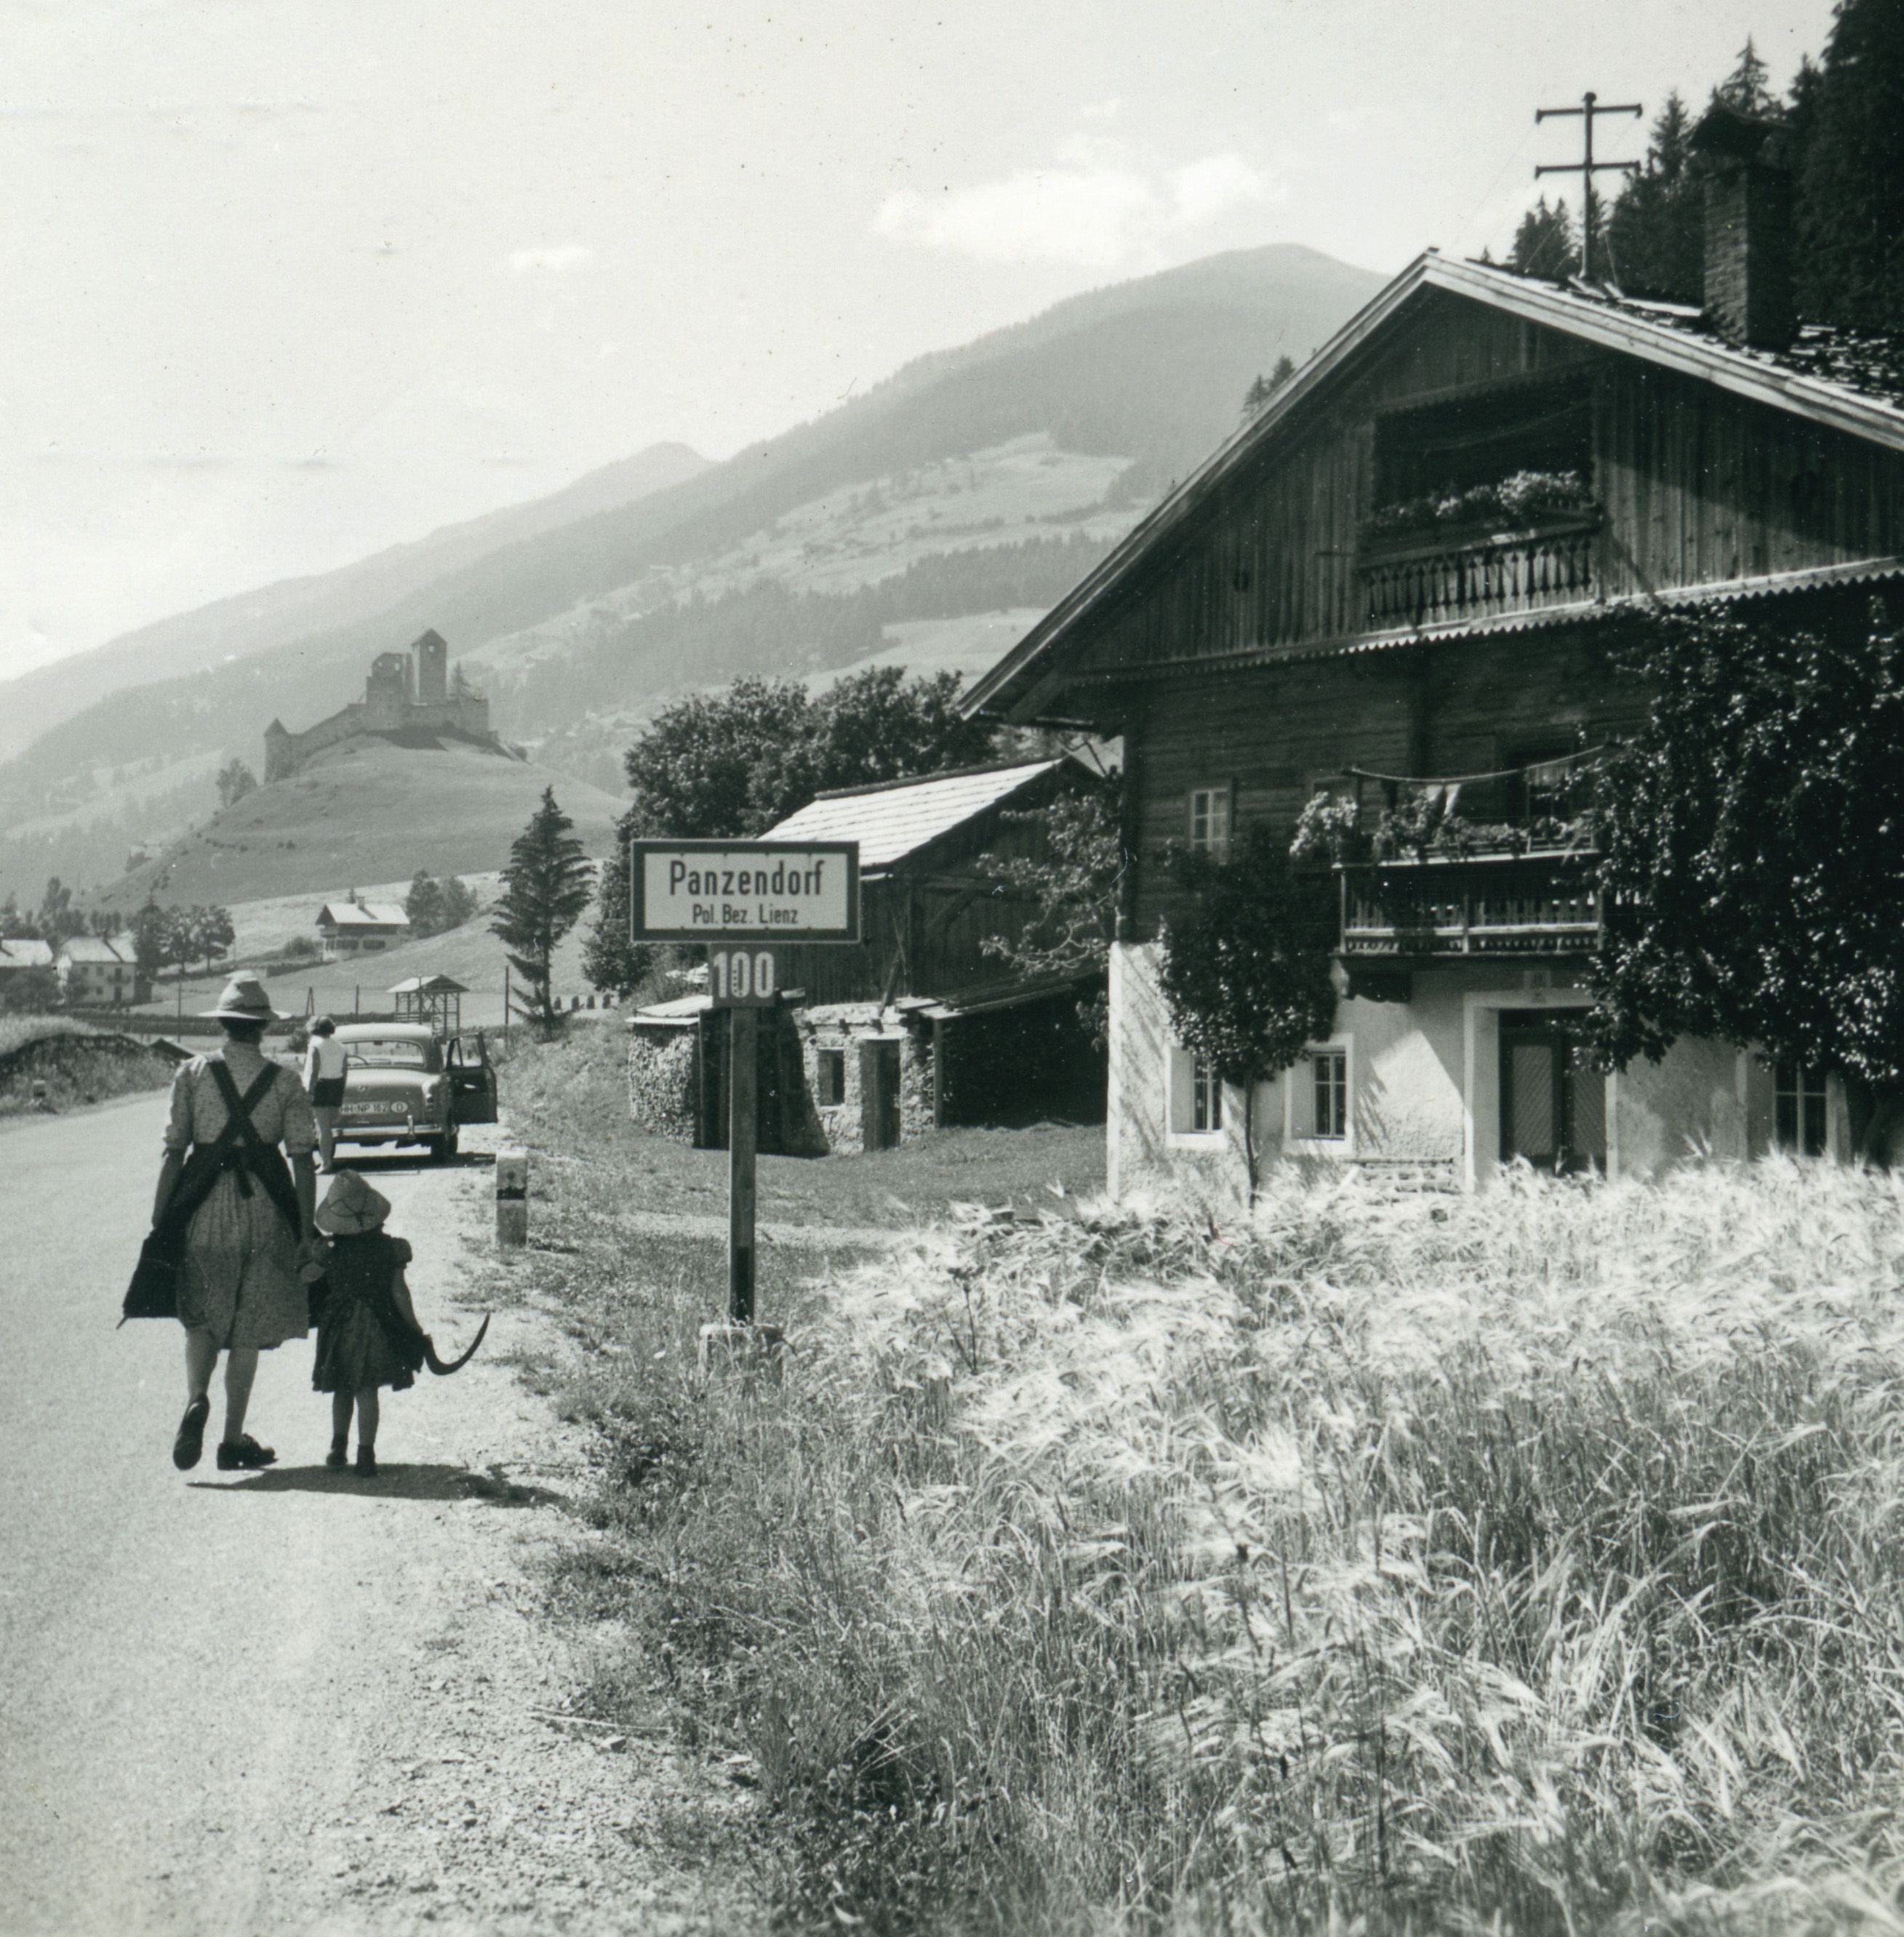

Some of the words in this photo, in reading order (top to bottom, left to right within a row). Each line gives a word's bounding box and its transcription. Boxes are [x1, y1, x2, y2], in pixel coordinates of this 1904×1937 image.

[670, 859, 825, 896] Panzendorf
[692, 904, 718, 924] Pol.
[722, 904, 753, 924] Bez.
[759, 903, 799, 924] Lienz
[713, 951, 775, 999] 100
